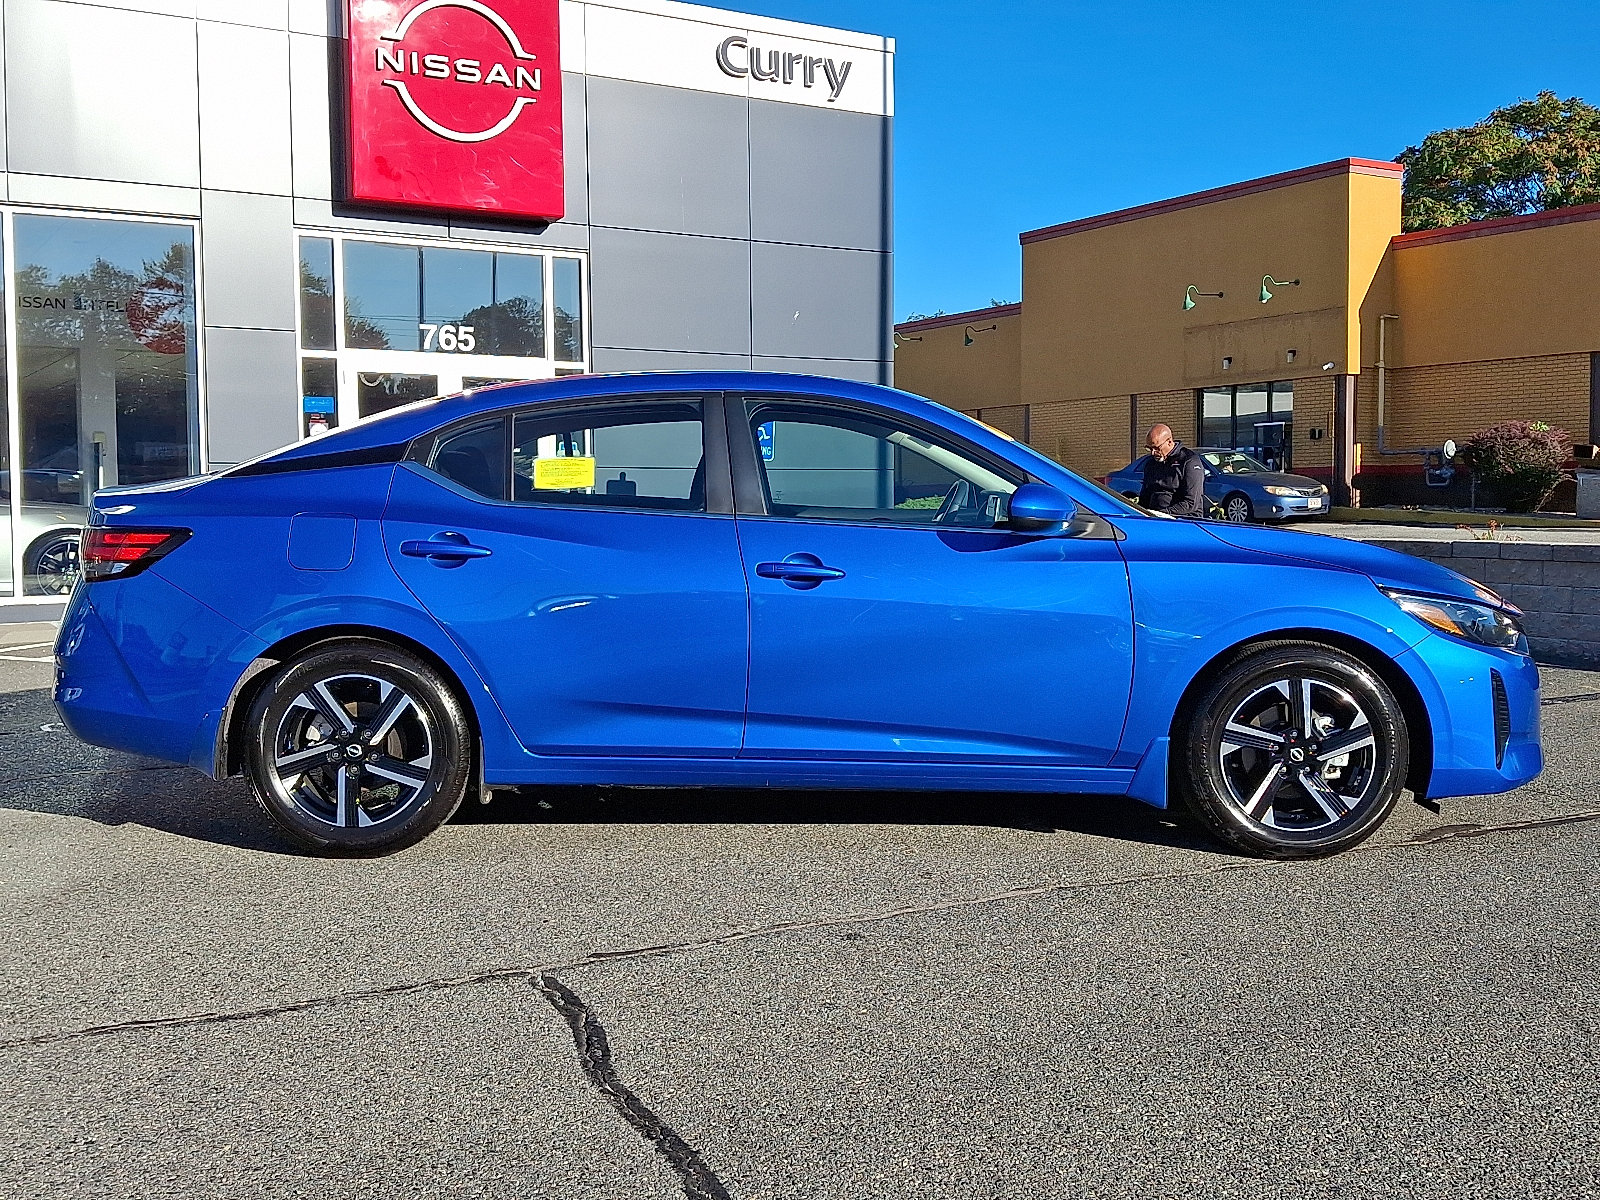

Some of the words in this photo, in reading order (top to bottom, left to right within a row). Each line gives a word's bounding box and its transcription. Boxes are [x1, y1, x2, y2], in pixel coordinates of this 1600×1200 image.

[375, 47, 542, 91] NISSAN
[716, 36, 852, 101] Curry
[17, 296, 66, 309] ISSAN
[418, 323, 476, 352] 765
